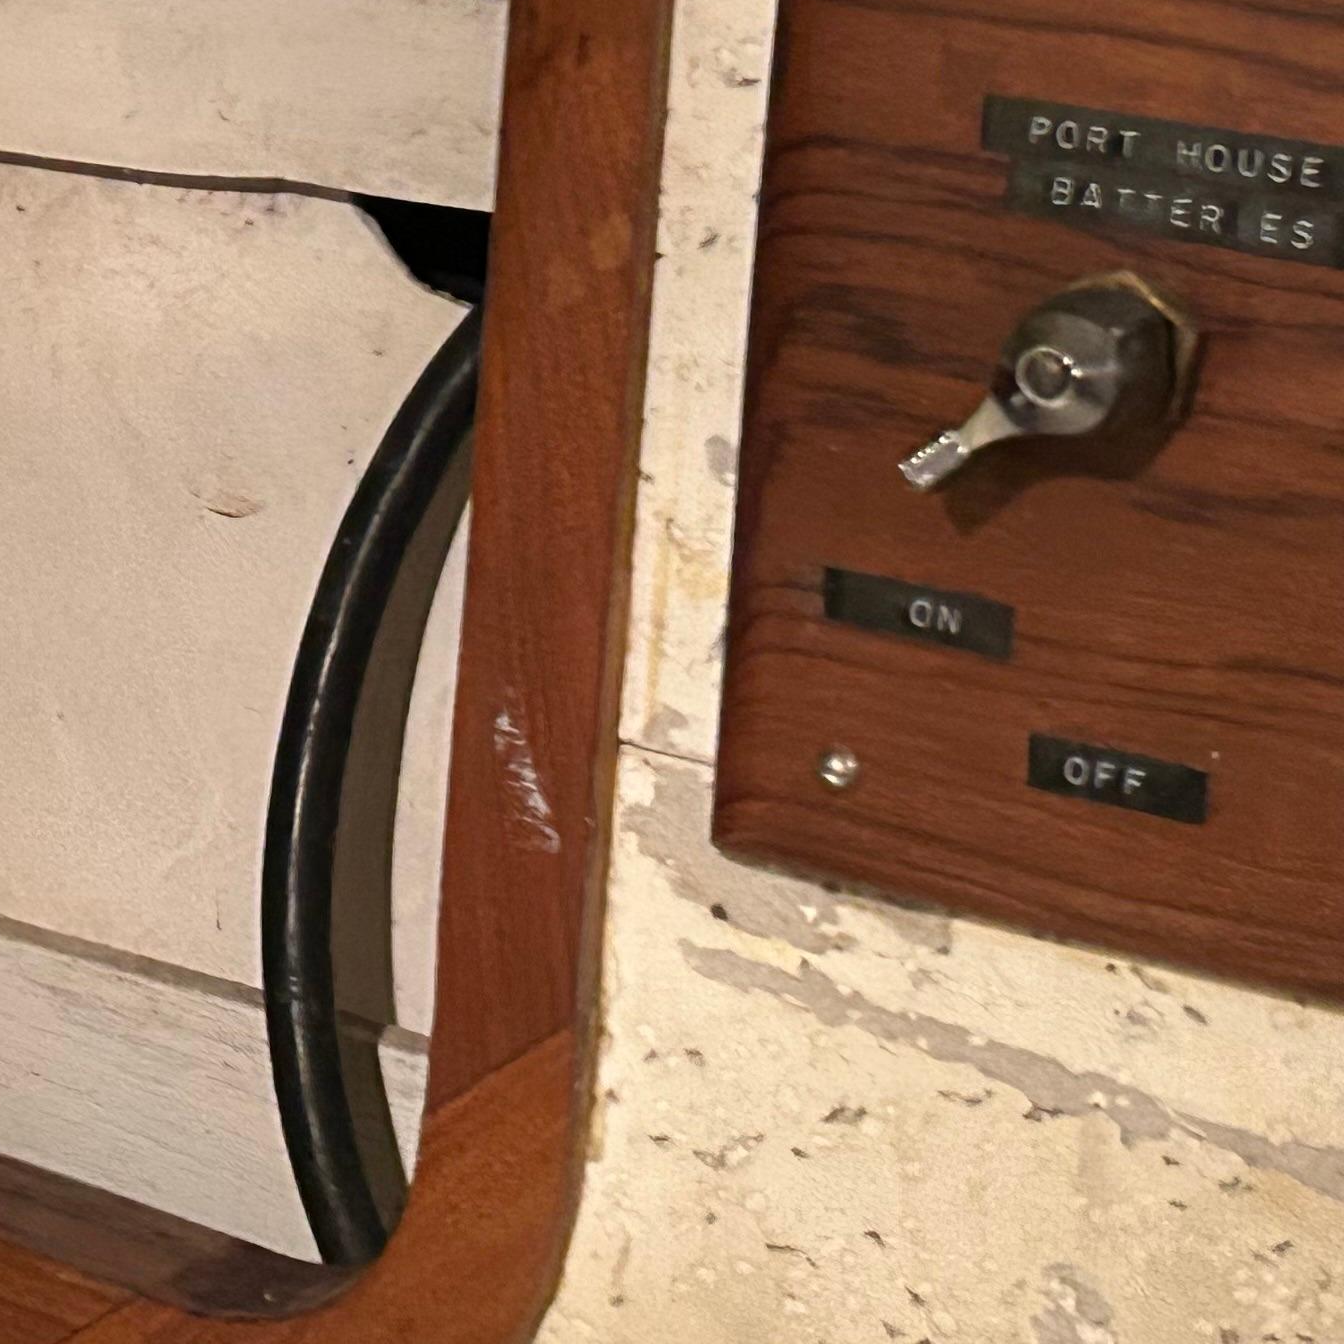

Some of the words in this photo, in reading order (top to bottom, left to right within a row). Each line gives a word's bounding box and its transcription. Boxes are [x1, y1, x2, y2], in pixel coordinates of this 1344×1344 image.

[1027, 115, 1142, 157] PORT
[1176, 139, 1325, 189] HOUSE
[1050, 175, 1315, 251] BATTERES
[908, 599, 962, 635] ON
[1063, 755, 1148, 796] OFF
